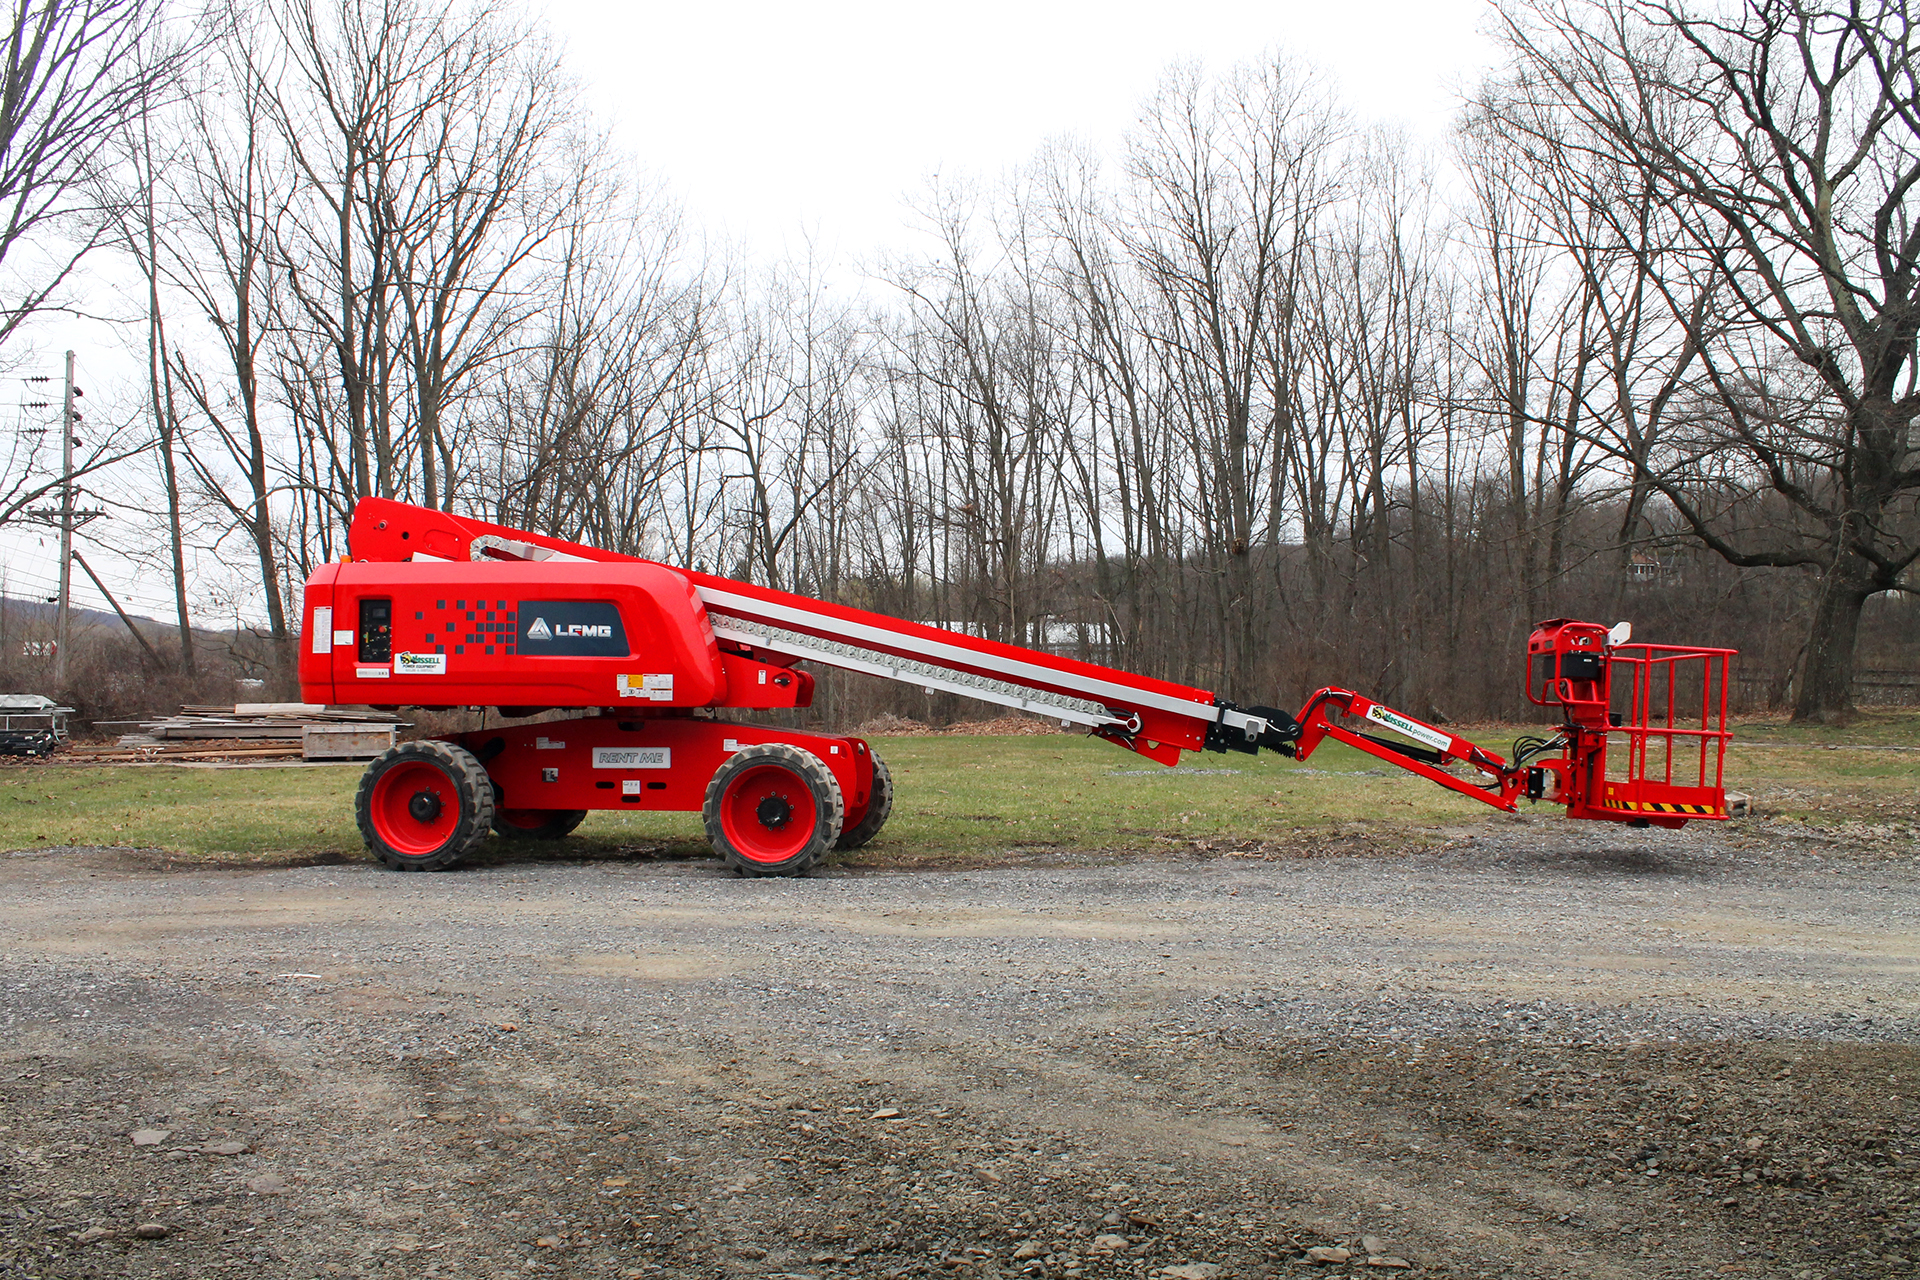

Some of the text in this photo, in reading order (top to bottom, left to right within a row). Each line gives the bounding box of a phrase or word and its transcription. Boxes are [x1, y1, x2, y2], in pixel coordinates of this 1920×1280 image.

[555, 624, 612, 637] LGMG
[599, 752, 664, 763] RENT ME
